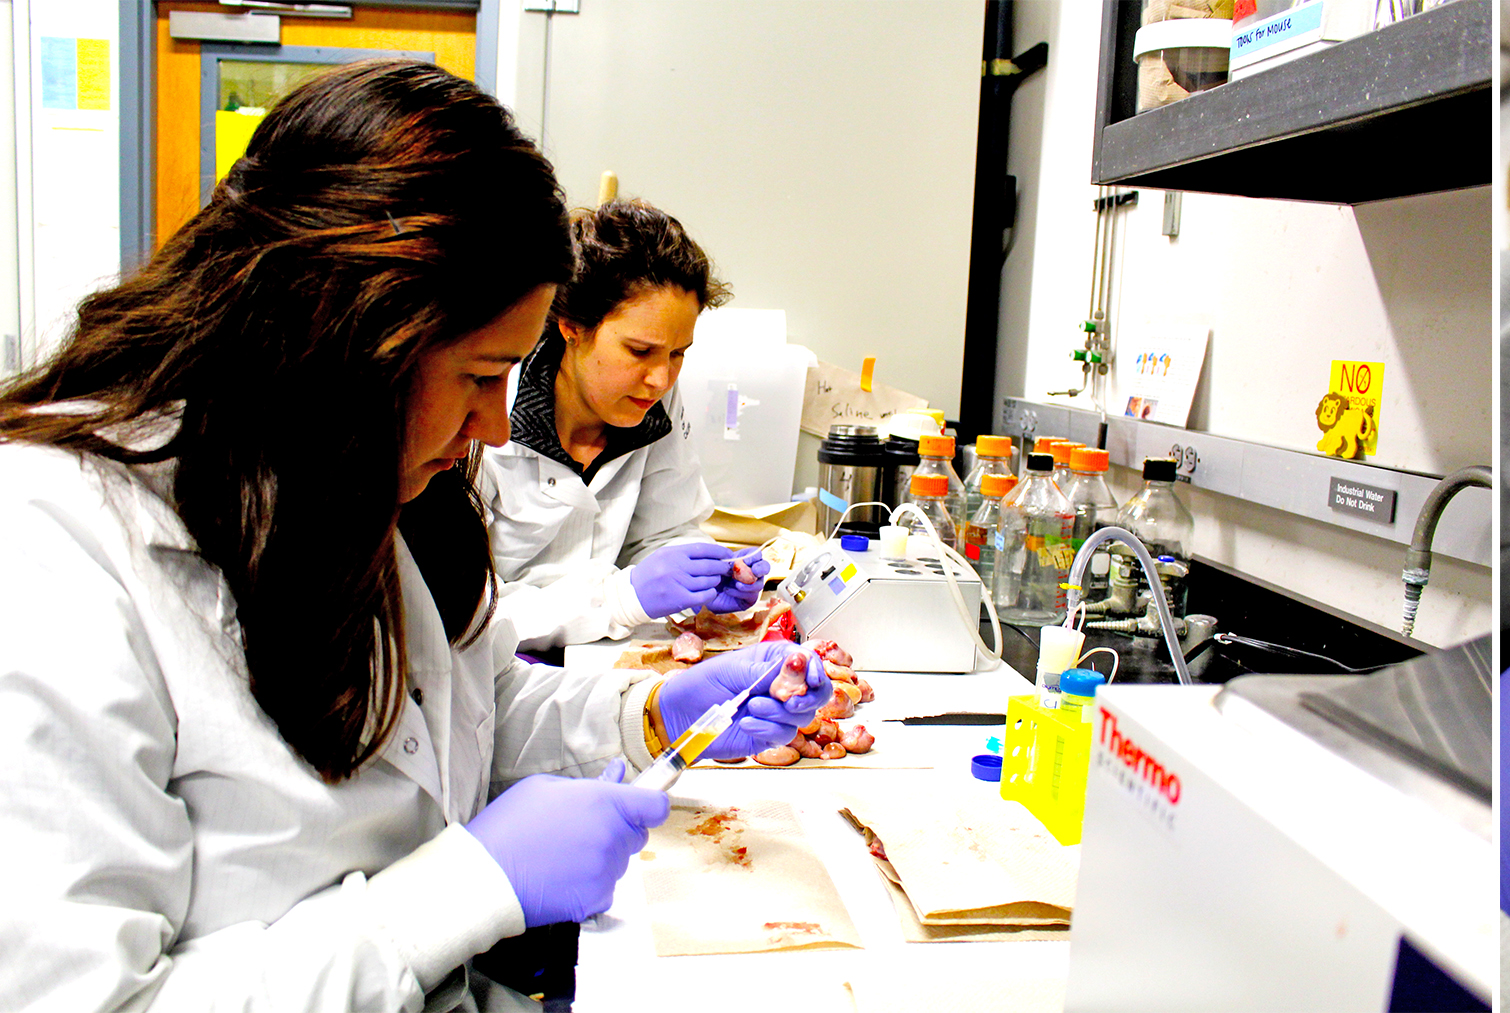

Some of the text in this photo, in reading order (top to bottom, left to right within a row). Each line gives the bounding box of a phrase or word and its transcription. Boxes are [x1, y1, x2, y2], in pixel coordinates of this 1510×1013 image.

[1339, 363, 1371, 395] NO
[1335, 494, 1375, 512] Do Not Drink
[1336, 483, 1384, 502] Industrial Water
[1098, 706, 1182, 806] Thermo
